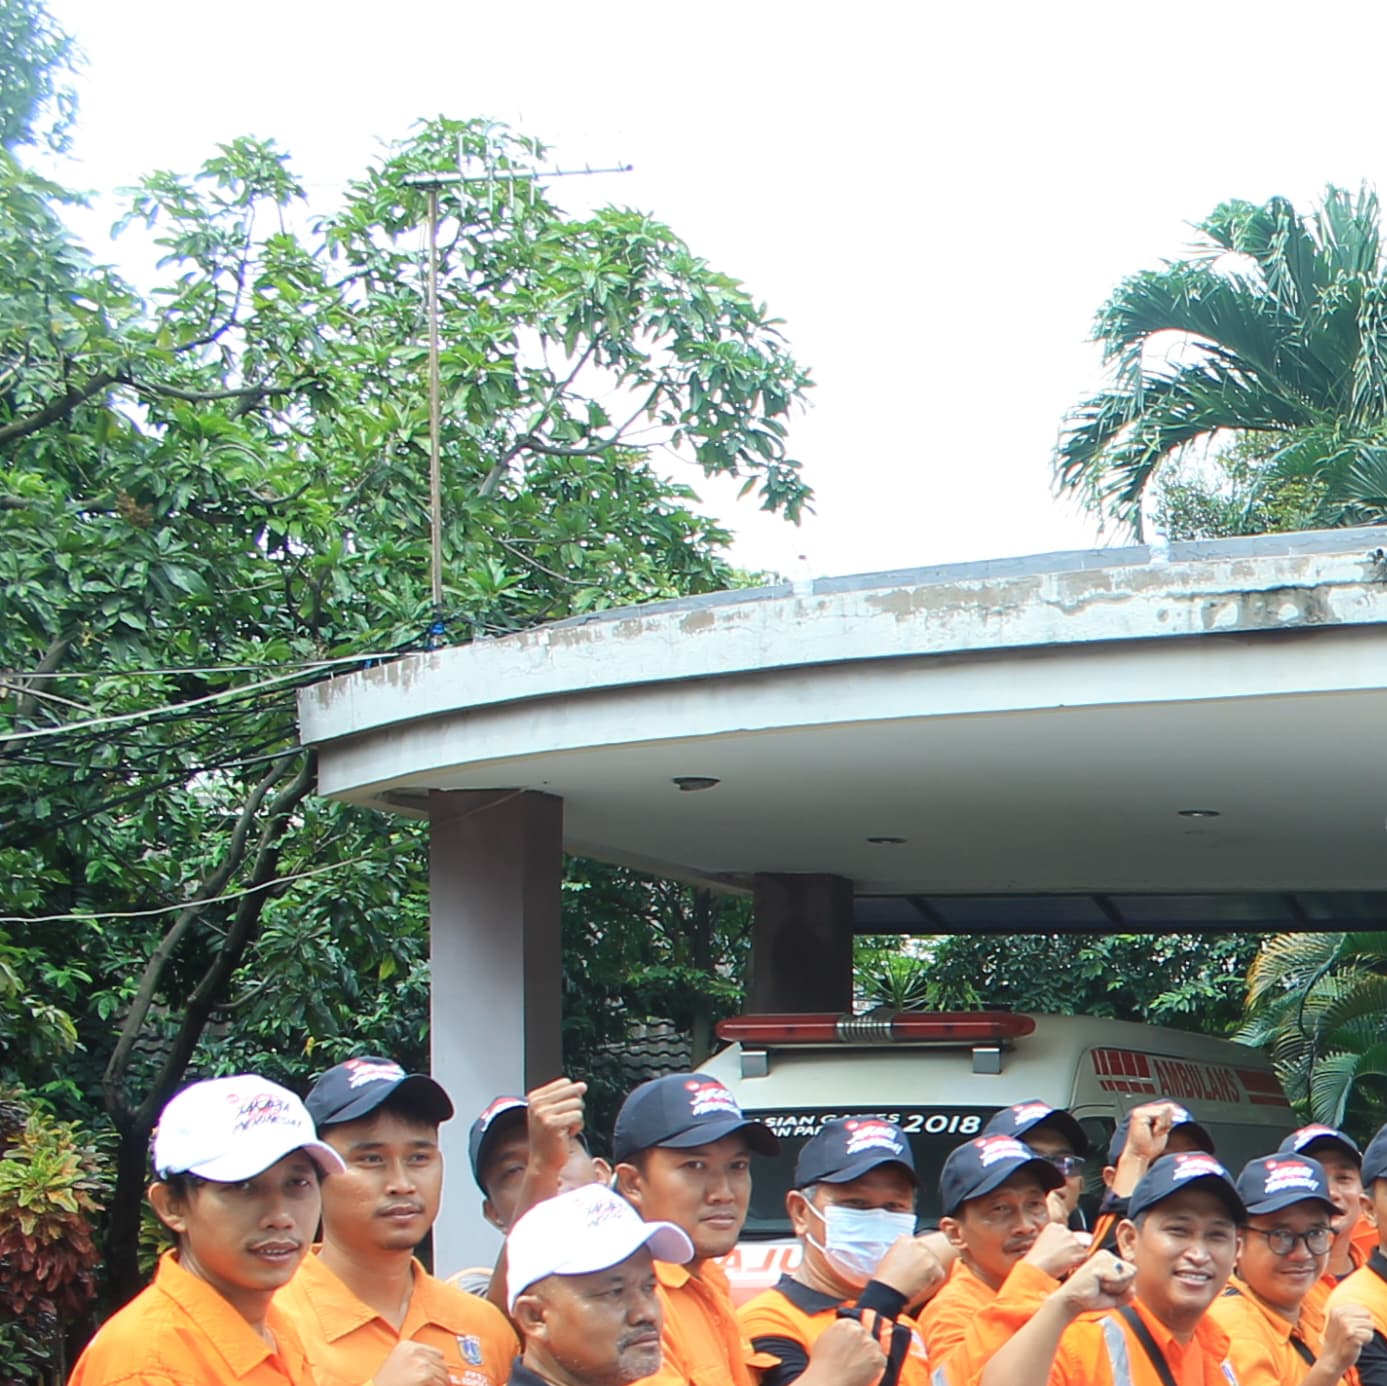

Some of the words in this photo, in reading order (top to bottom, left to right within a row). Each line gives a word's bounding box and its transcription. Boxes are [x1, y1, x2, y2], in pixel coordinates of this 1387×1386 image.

[1153, 1059, 1241, 1103] AMBULANS
[752, 1114, 816, 1127] SIAN
[903, 1113, 982, 1134] 2018
